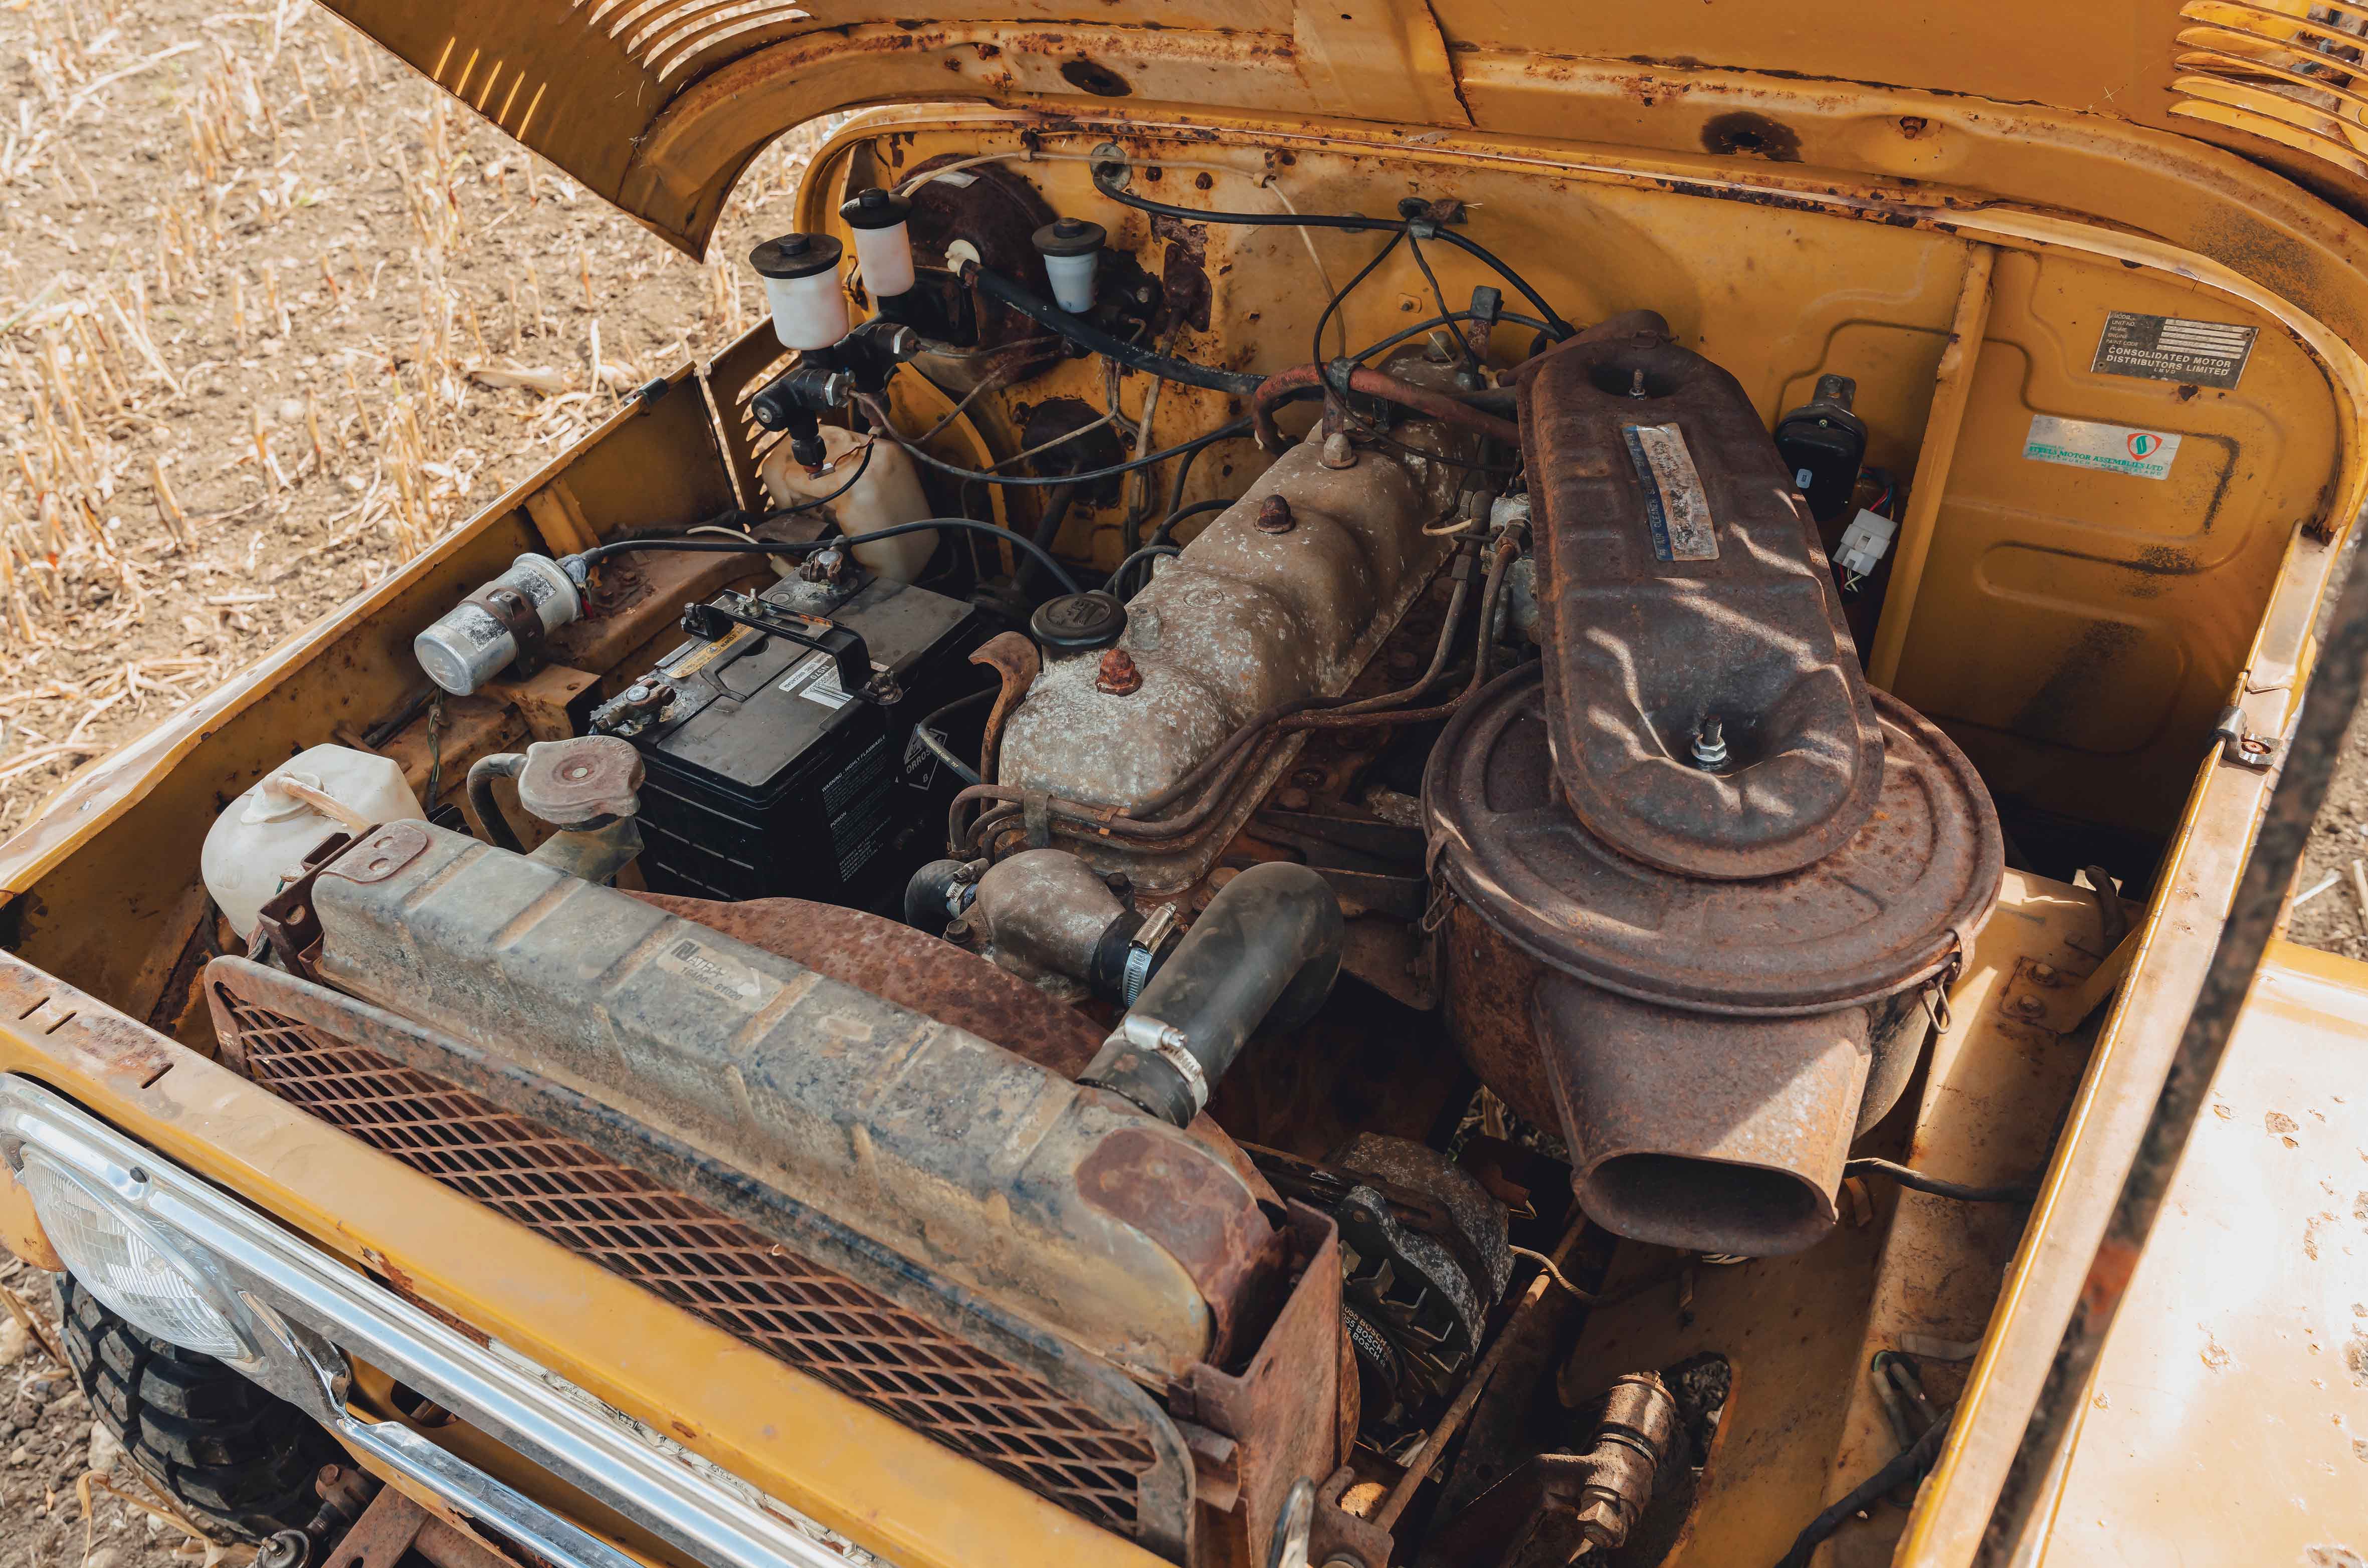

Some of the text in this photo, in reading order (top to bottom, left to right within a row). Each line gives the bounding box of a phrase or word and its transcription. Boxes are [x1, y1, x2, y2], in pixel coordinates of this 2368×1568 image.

[2106, 355, 2229, 376] DISTRIBUTORS LIMITED
[2108, 347, 2231, 367] CONSOLIDATED MOTOR
[2059, 451, 2091, 460] MOTOR
[2093, 456, 2145, 468] ASSEMBLIES
[1656, 533, 1665, 546] AIR
[810, 665, 831, 680] NS70
[822, 734, 886, 792] WARNING HIGHLY FLAMMABLE
[940, 752, 951, 762] CORE
[830, 810, 847, 828] POISON
[670, 940, 724, 978] NATRA
[1355, 1324, 1383, 1354] BOSCH
[1359, 1318, 1387, 1347] BOSCH
[1352, 1331, 1379, 1361] BOSCH
